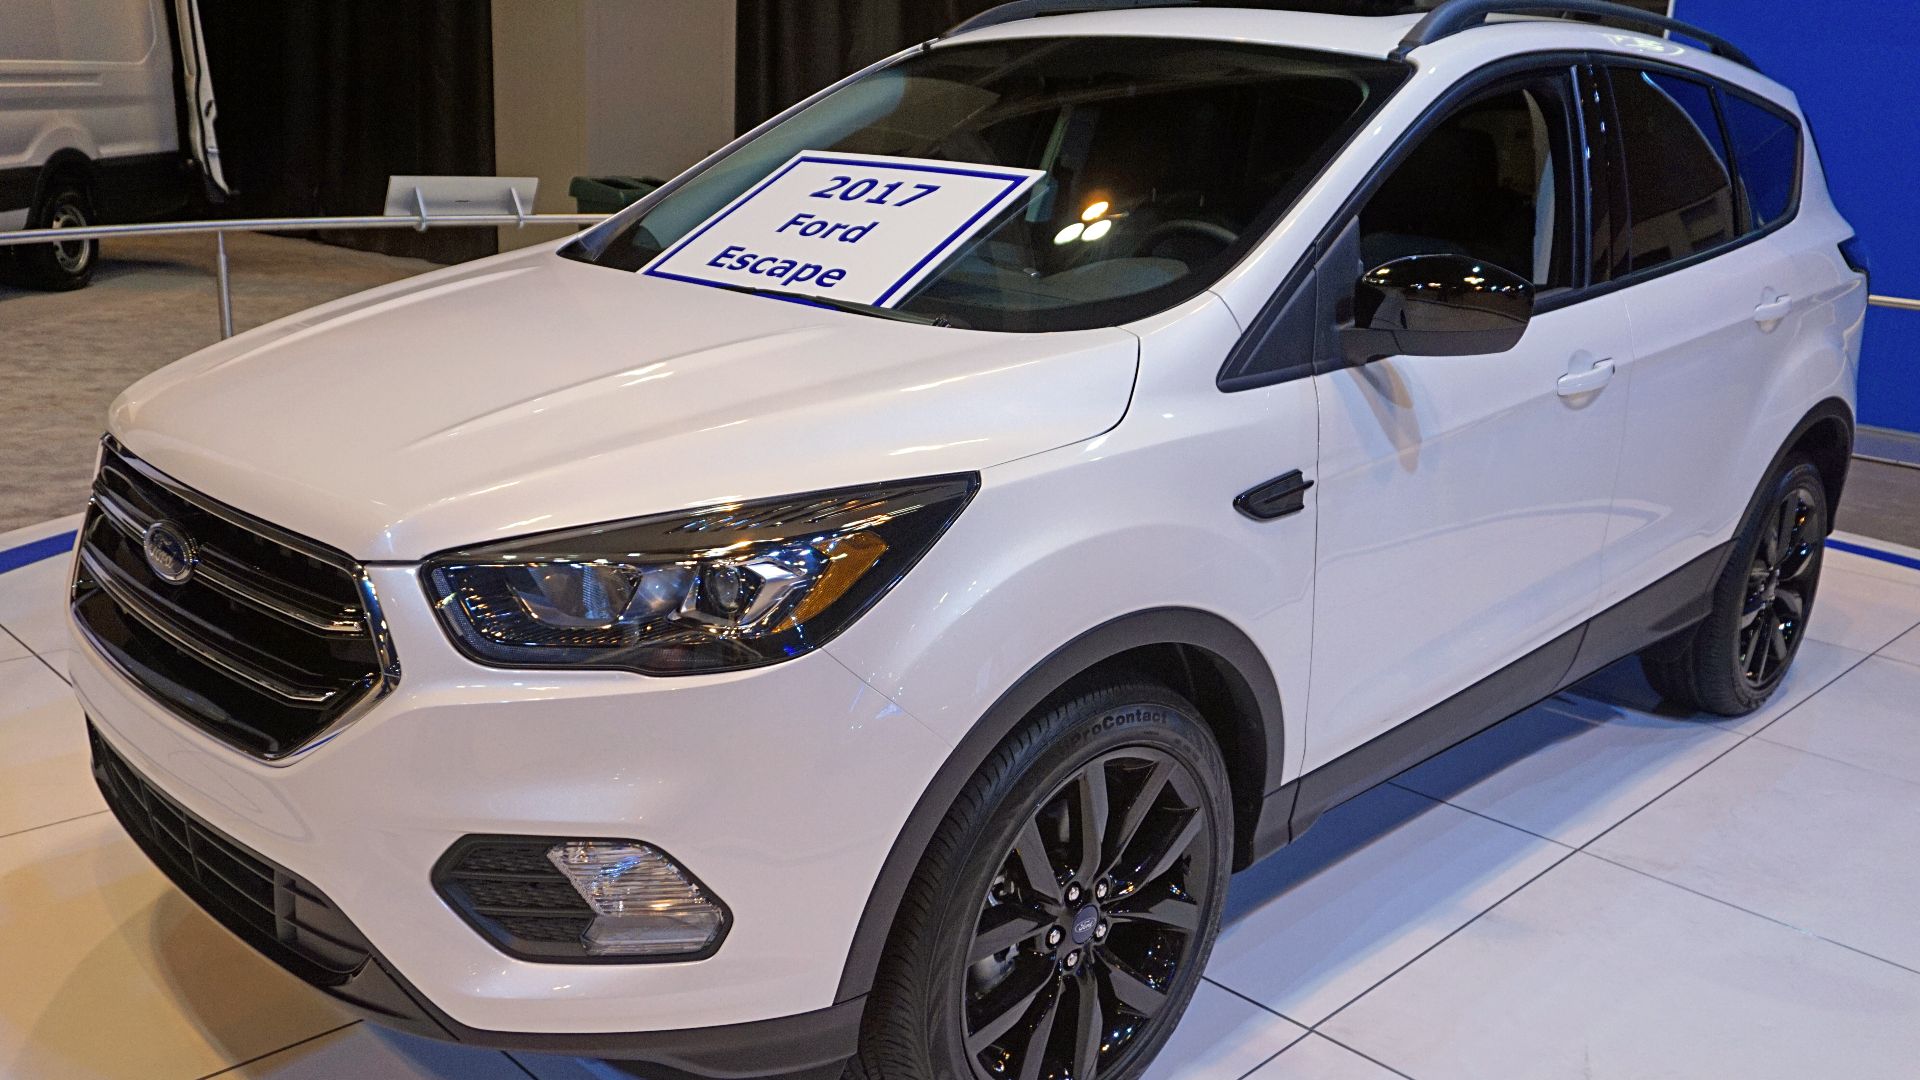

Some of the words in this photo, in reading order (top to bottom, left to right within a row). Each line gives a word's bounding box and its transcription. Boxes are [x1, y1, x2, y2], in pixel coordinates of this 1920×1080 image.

[810, 175, 941, 207] 2017
[776, 213, 880, 244] Ford
[706, 246, 847, 287] Escape
[1071, 709, 1167, 745] ProContact
